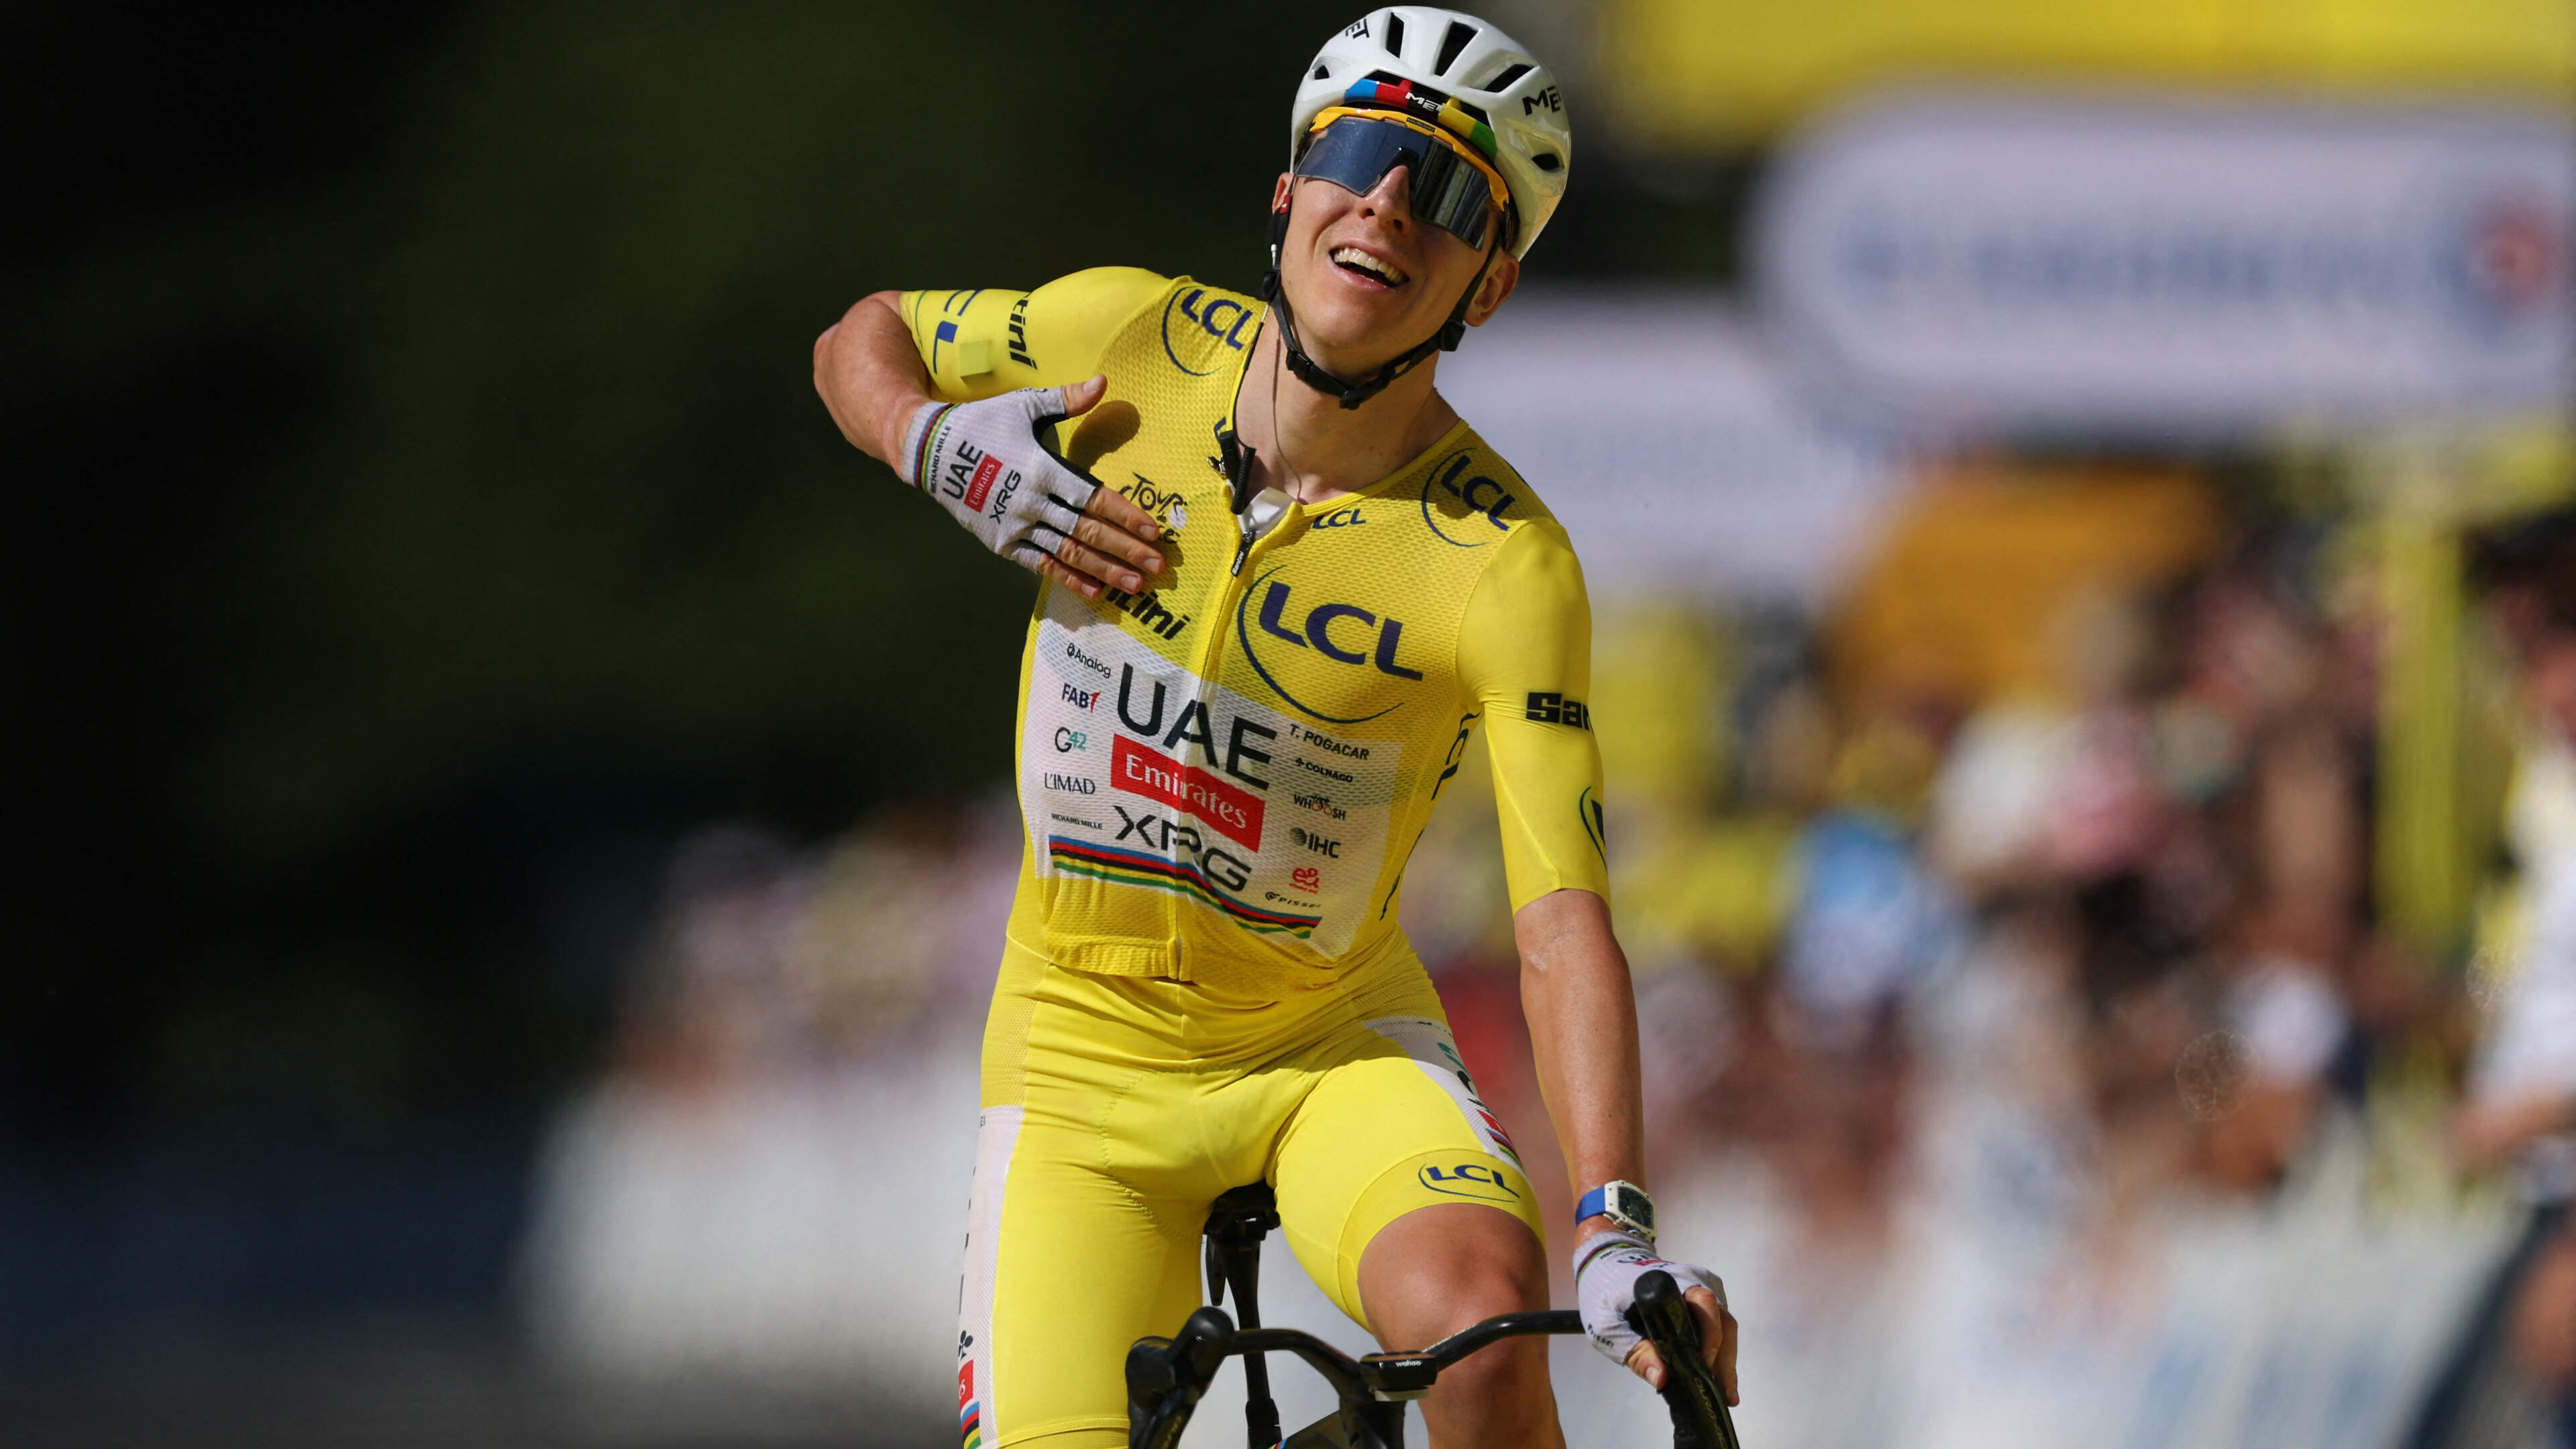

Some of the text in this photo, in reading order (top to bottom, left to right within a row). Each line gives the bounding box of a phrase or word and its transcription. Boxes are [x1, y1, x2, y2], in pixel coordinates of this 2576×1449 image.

[1009, 291, 1038, 370] tini
[1181, 289, 1253, 351] LCL
[937, 425, 951, 454] MILLE
[943, 440, 983, 500] UAE
[970, 464, 996, 506] Emirates
[989, 470, 1022, 525] XRG
[1441, 454, 1516, 532] LCL
[1311, 508, 1366, 529] LCL
[1258, 580, 1424, 681] LCL
[1074, 648, 1111, 679] Analog
[1055, 727, 1087, 753] G42
[1118, 661, 1277, 791] UAE
[1290, 723, 1370, 761] T. POGACAR
[1126, 753, 1248, 829] Emirates
[1305, 762, 1354, 783] COLNAGO
[1051, 812, 1104, 830] RICHARD MILLE
[1112, 805, 1252, 892] XRG
[1308, 833, 1341, 859] IHC
[1426, 1165, 1520, 1198] LCL
[1395, 1359, 1422, 1368] wahoo
